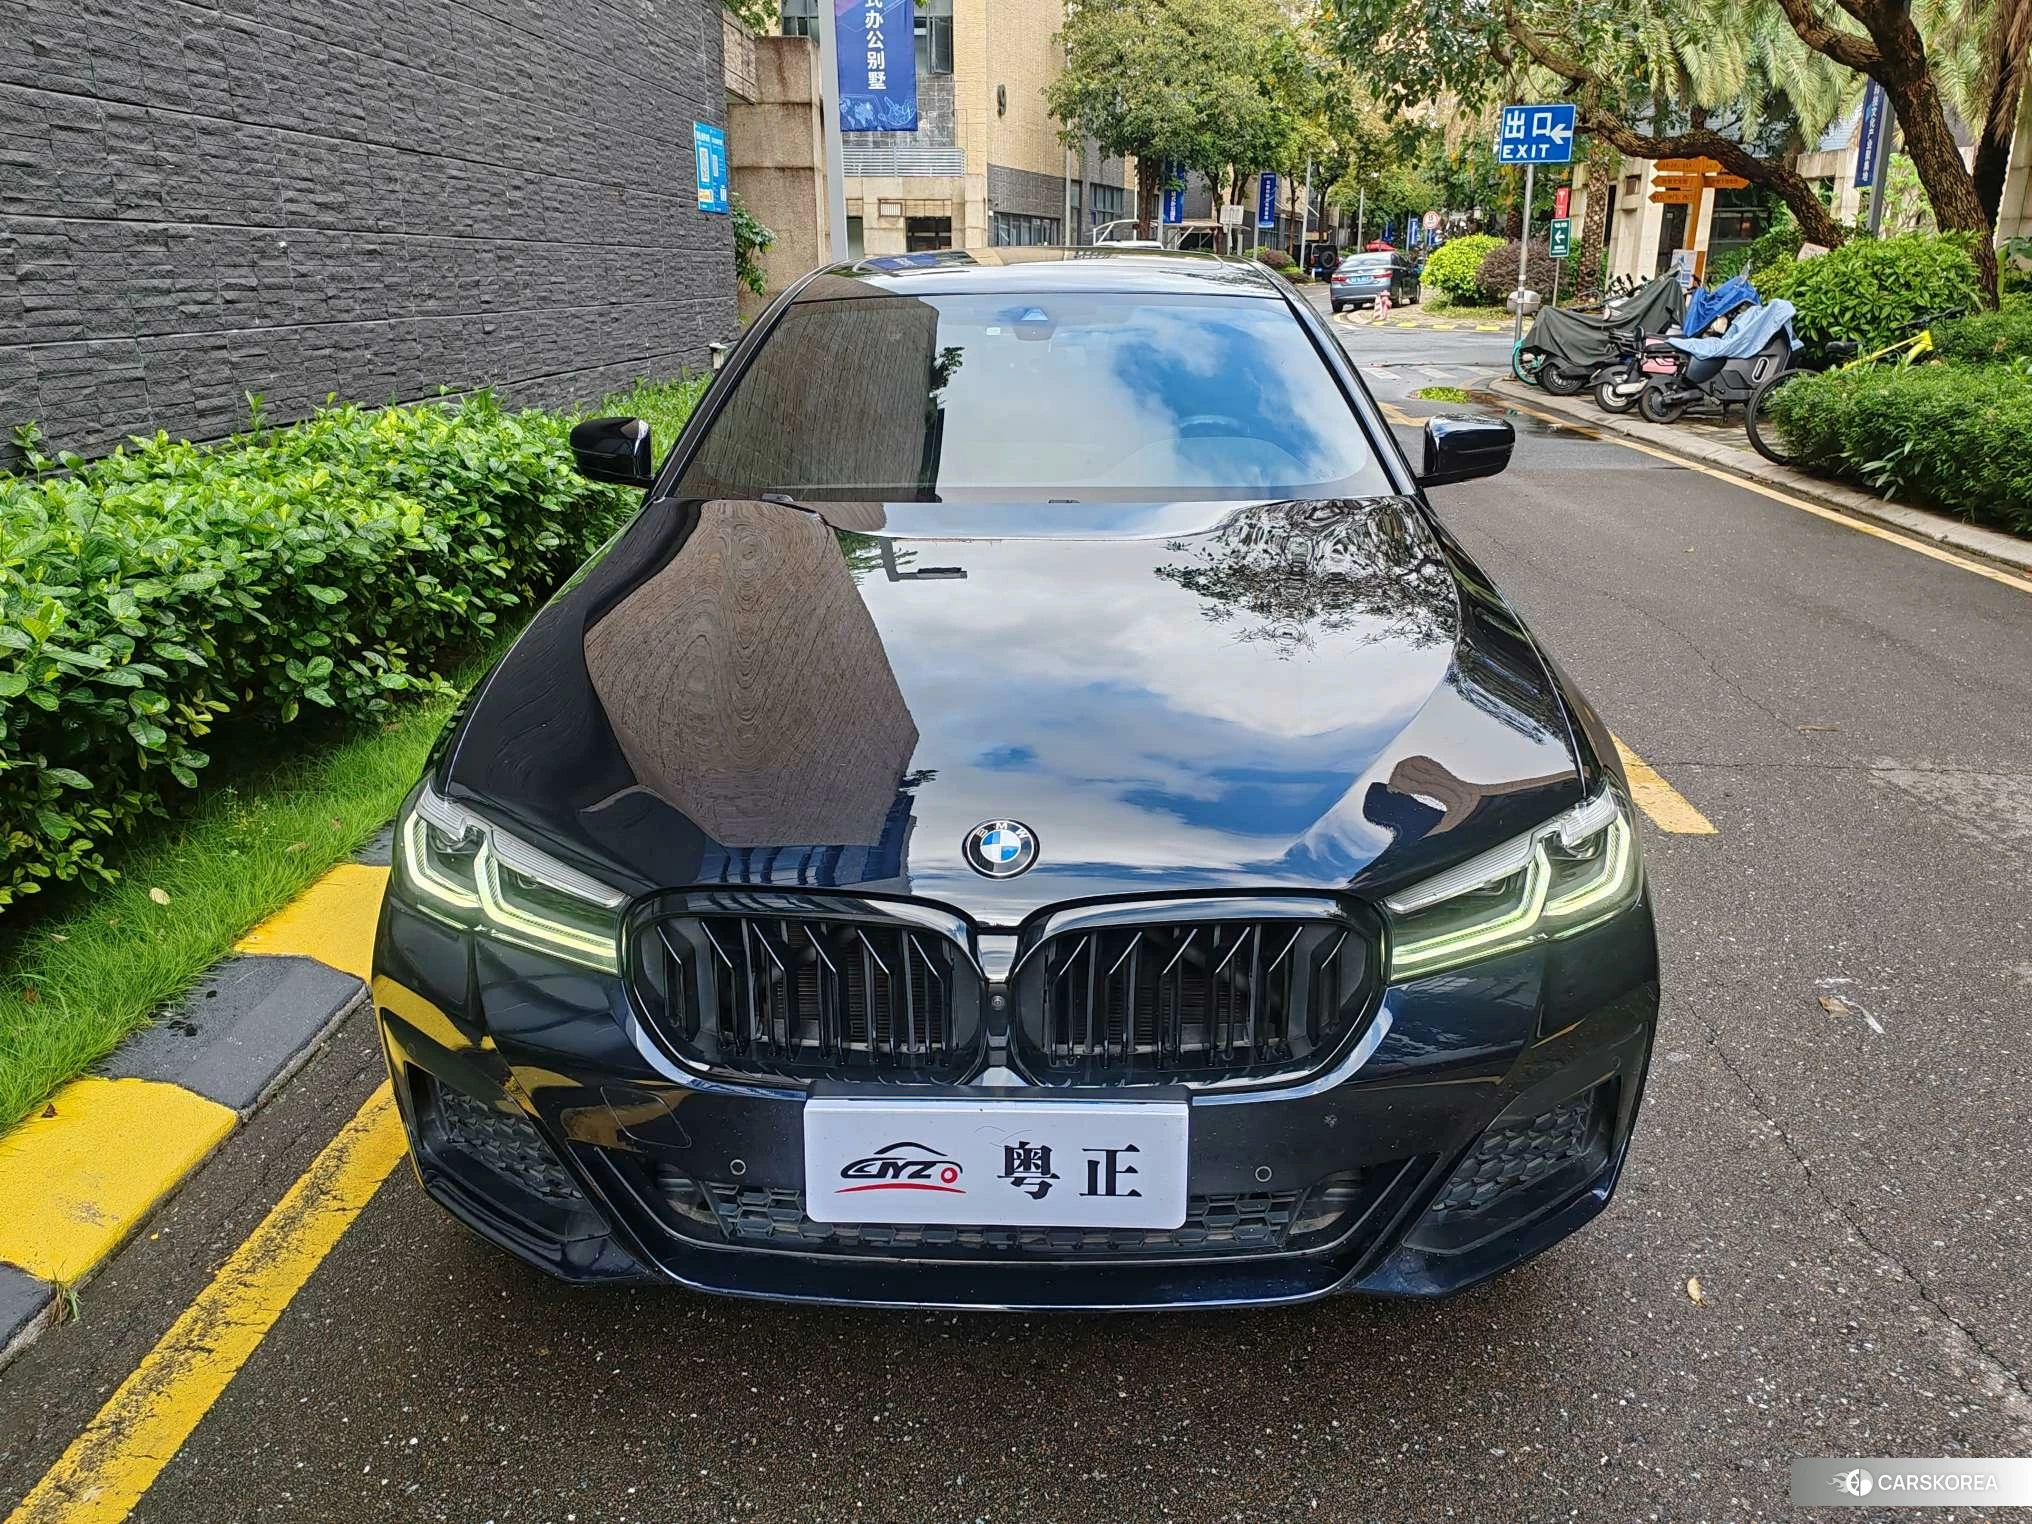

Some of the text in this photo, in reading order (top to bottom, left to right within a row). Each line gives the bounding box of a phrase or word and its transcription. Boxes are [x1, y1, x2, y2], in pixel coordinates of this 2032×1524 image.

[1504, 110, 1552, 139] 出口
[1502, 144, 1550, 159] EXIT
[976, 822, 1029, 839] BMW
[997, 1141, 1142, 1199] 粤正
